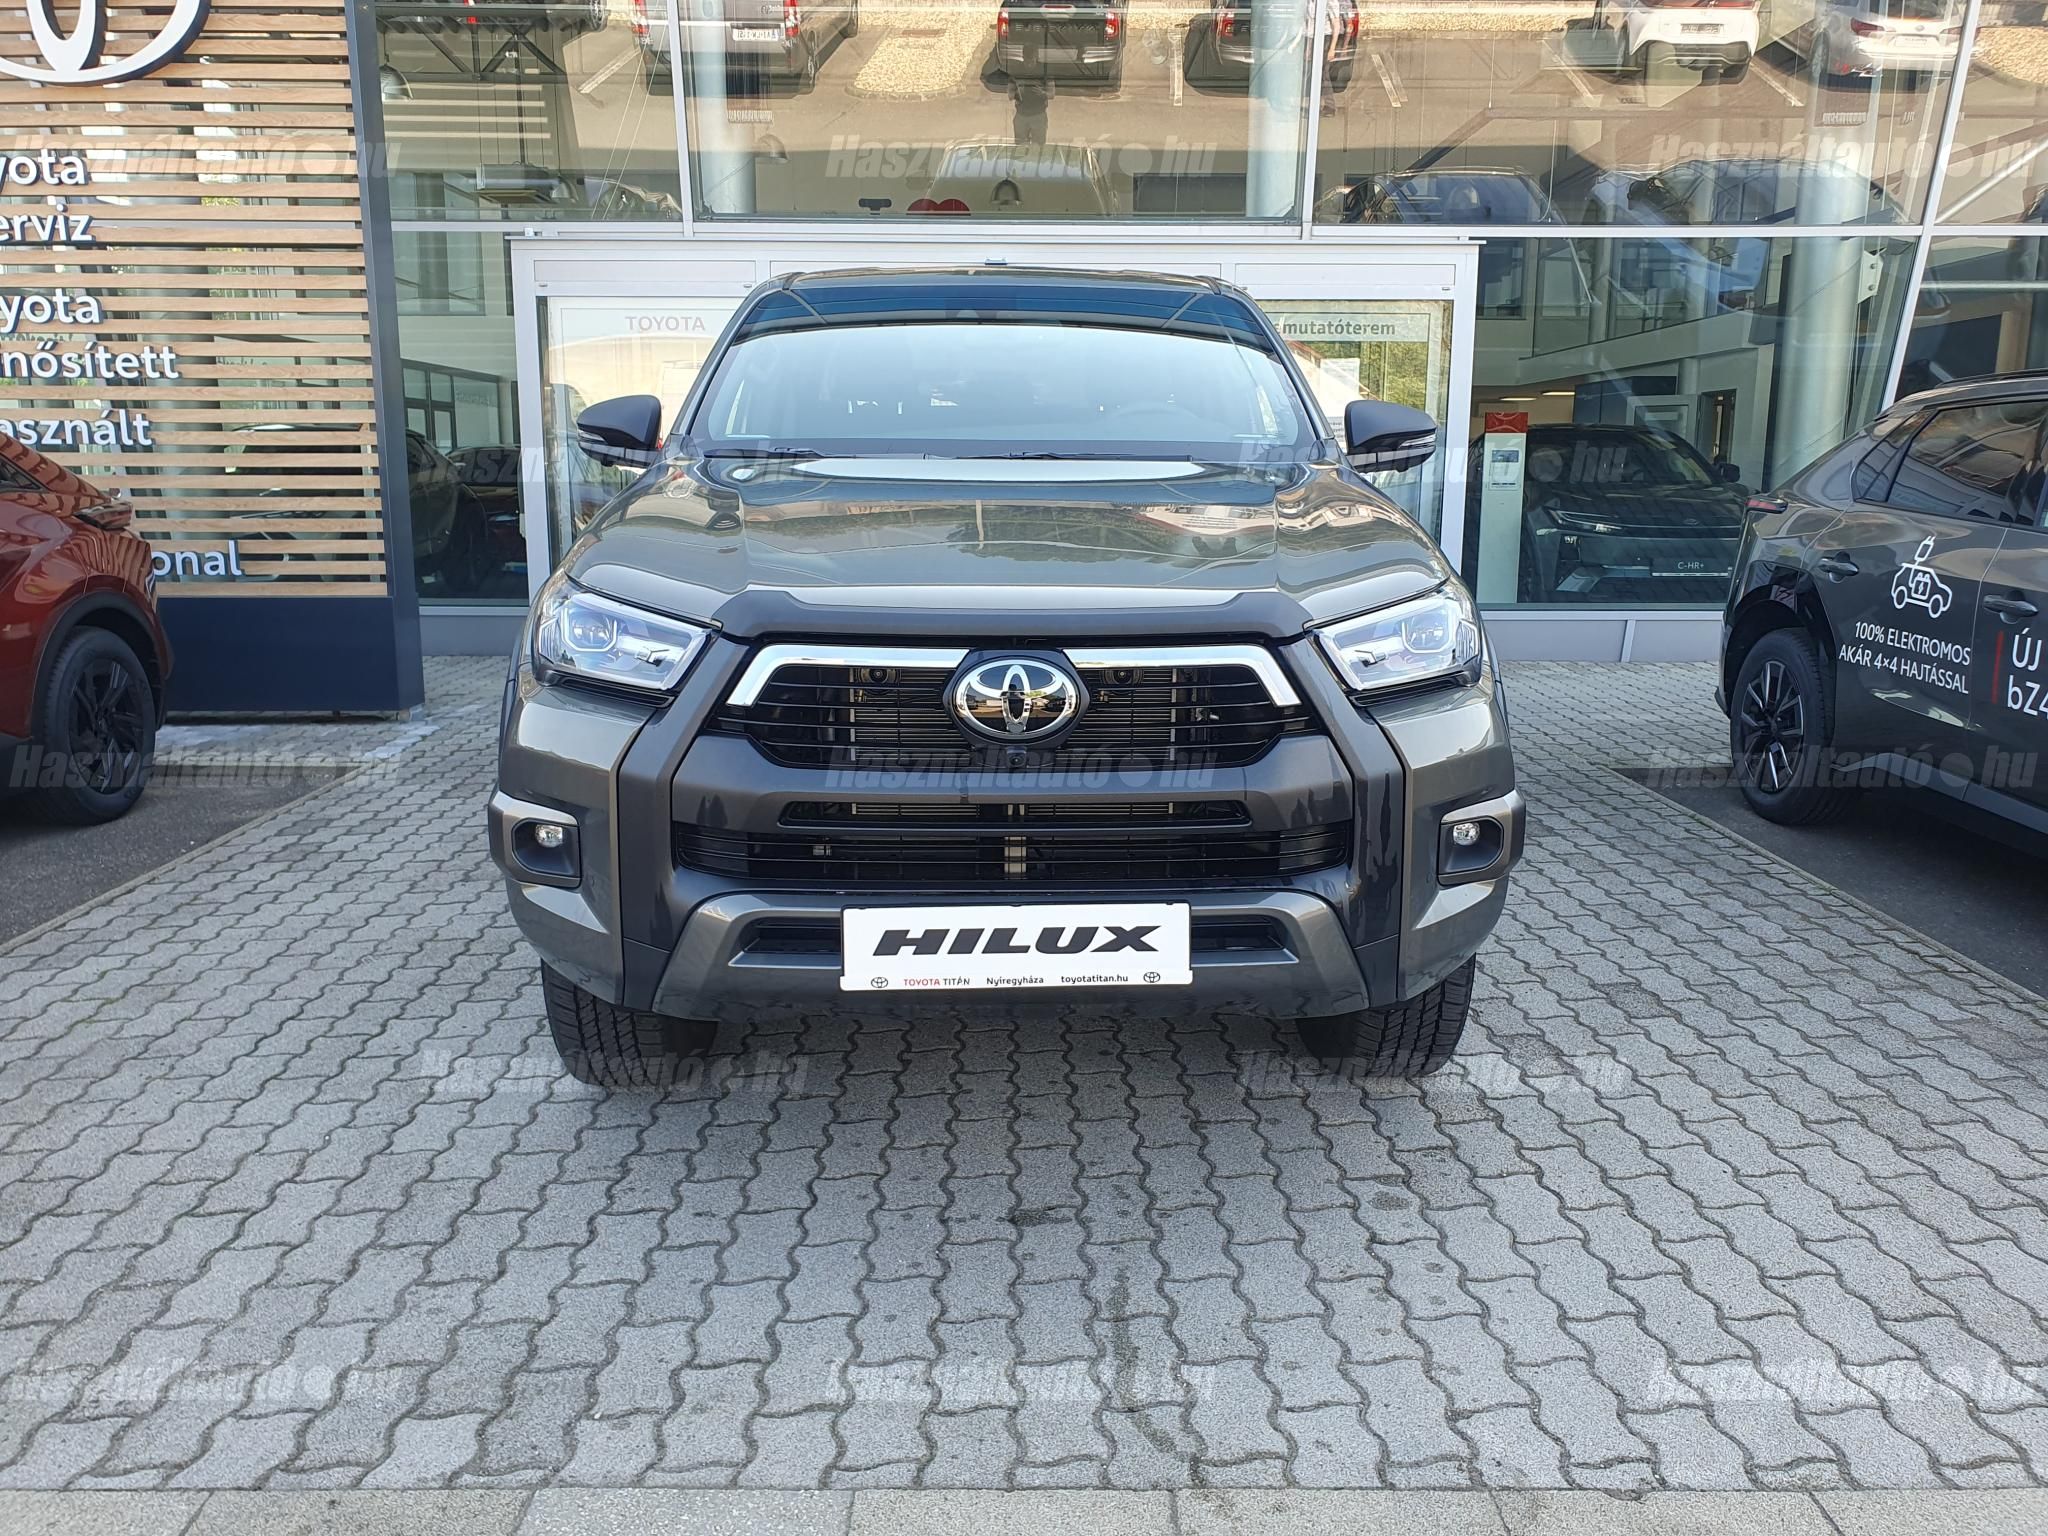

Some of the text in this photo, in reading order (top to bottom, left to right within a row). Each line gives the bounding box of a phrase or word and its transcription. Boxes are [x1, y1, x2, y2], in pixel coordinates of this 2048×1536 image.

[625, 315, 706, 332] TOYOTA
[1677, 561, 1705, 570] C-HR+
[1855, 621, 1972, 666] 100% ELEKTROMOS
[2012, 627, 2043, 671] ÚJ
[1838, 644, 1872, 668] AKÁR
[1899, 659, 1969, 694] HAJTÁSSAL
[872, 925, 1162, 957] HILUX
[903, 974, 1129, 986] TOYOTA TITÁN Nyíregyháza toyotatitan.hu
